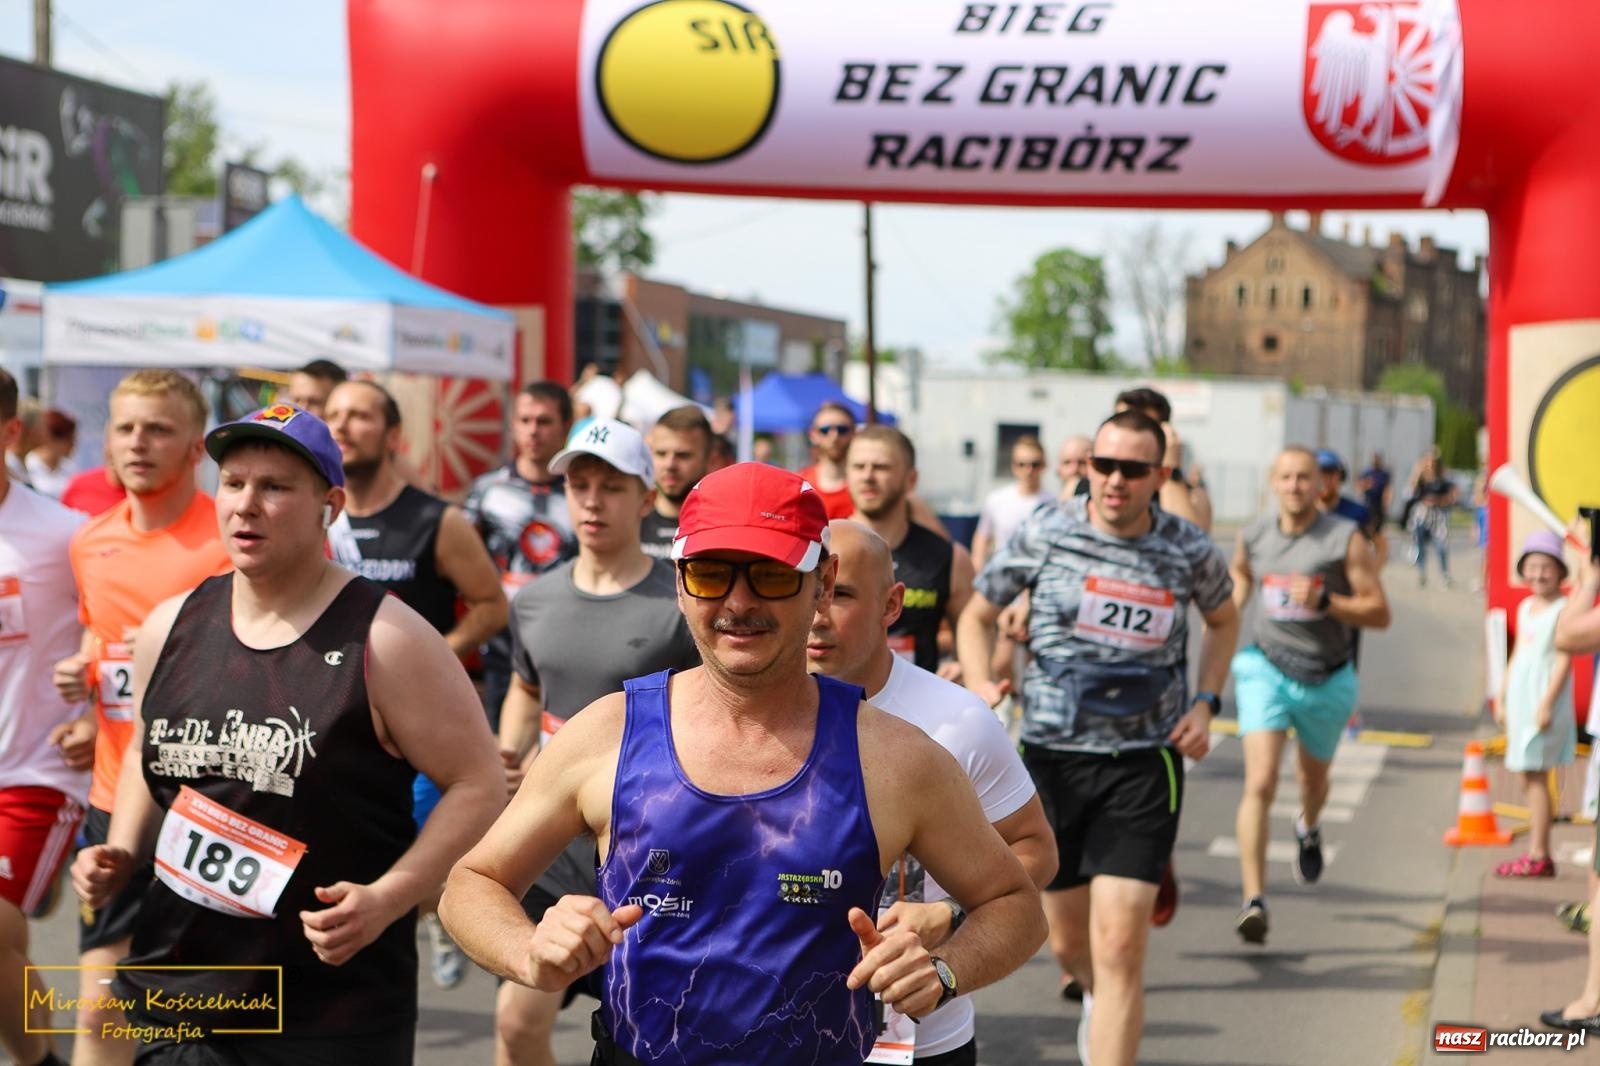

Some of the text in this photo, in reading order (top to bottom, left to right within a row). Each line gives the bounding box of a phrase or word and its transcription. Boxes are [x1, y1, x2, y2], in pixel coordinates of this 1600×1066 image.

[955, 3, 1112, 34] BIEG
[834, 62, 1228, 106] BEZ GRANIC
[1100, 602, 1153, 634] 212
[182, 829, 262, 897] 189
[821, 869, 843, 890] 10
